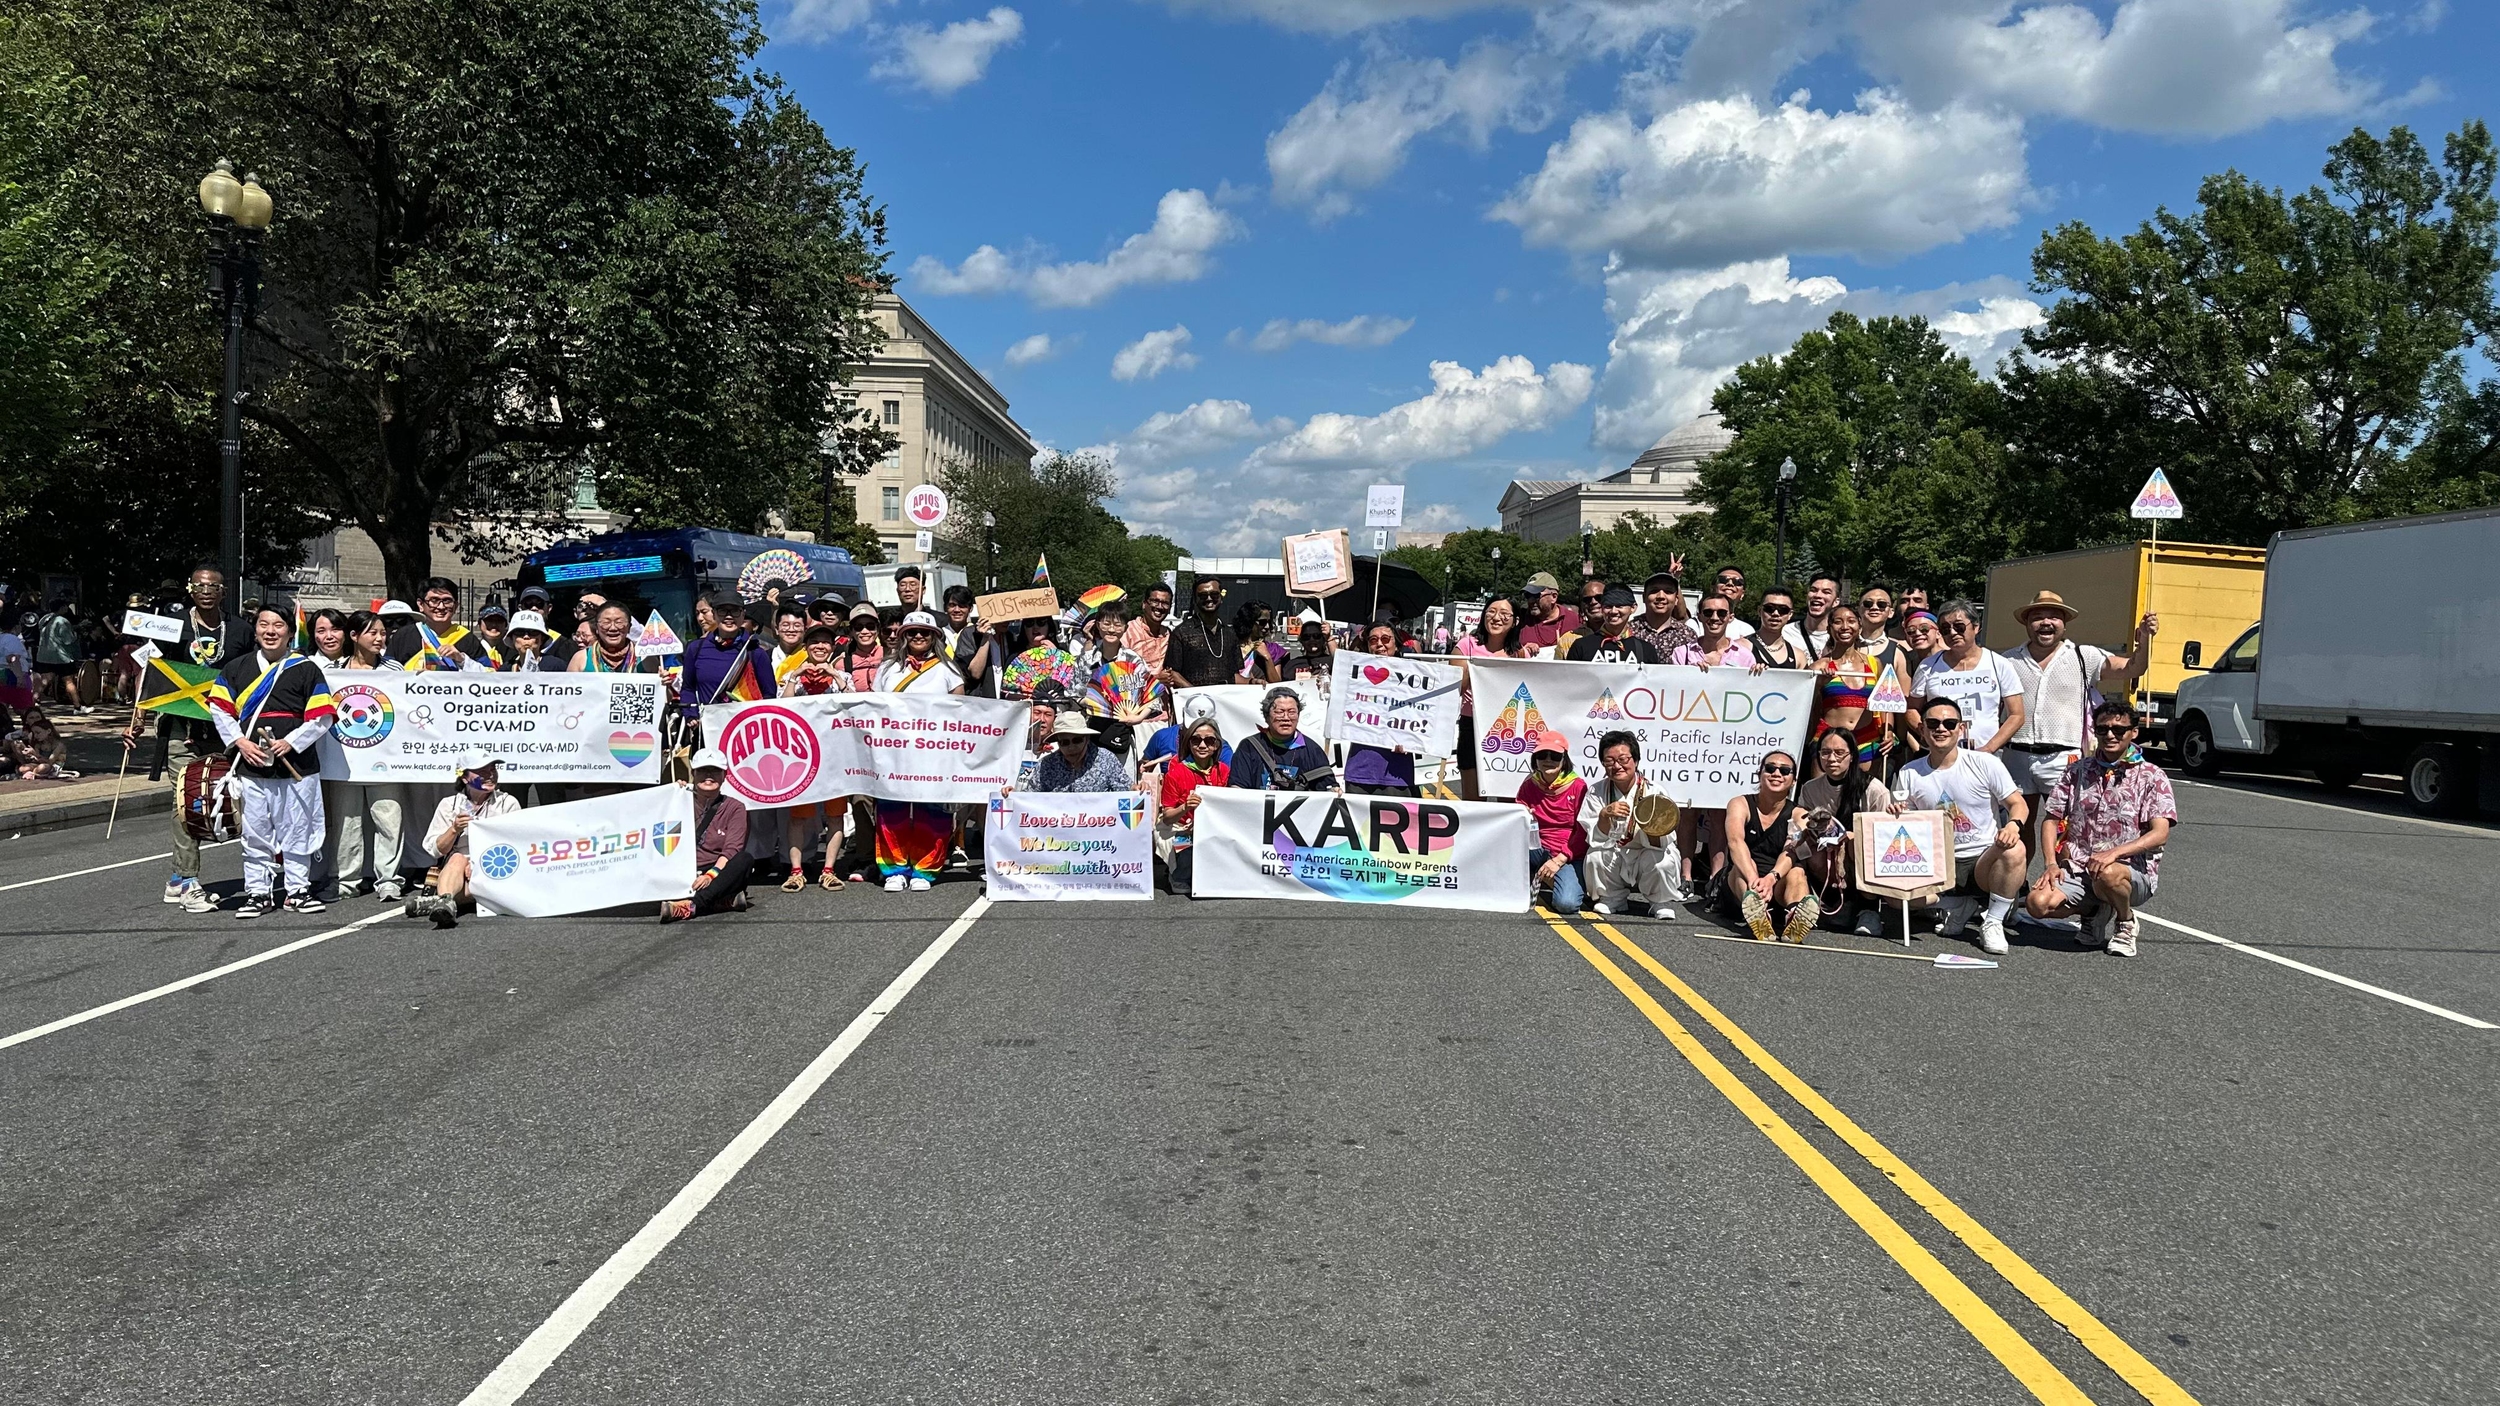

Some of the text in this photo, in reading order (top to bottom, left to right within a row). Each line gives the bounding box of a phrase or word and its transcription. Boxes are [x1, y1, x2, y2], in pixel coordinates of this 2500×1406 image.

[914, 493, 939, 508] APIQS
[1300, 561, 1331, 571] KhushDC
[982, 596, 1055, 617] JUST MARRIED
[1352, 665, 1359, 679] I
[1941, 676, 1989, 686] KQT DC
[340, 686, 380, 698] KQT DC
[405, 683, 583, 697] Korean Queer & Trans
[444, 701, 549, 717] Organization
[831, 717, 1009, 737] Asian Pacific Islander
[1387, 717, 1428, 733] are!
[731, 718, 809, 767] APIQS
[864, 734, 976, 753] Queer Society
[1637, 729, 1648, 742] &
[1661, 730, 1711, 744] Pacific
[1720, 731, 1784, 747] Islander
[402, 742, 425, 754] 한인
[429, 743, 470, 754] 성소수자
[1646, 749, 1762, 766] United for Acti
[391, 763, 452, 771] www.kqtdc.org
[519, 763, 611, 771] koreanqt.dc@gmail.com
[1582, 765, 1744, 786] WINGTON,
[726, 765, 817, 803] ASIAN PACIFIC ISLANDER QUEER SOCIETY
[845, 768, 880, 780] Visibility
[888, 772, 943, 782] Awareness
[951, 775, 1008, 785] Community
[1019, 813, 1116, 827] Love is Love
[1262, 794, 1460, 856] KARP
[527, 828, 646, 865] 성요한교회
[1020, 836, 1117, 855] We love you,
[547, 864, 572, 873] JOHN'S
[573, 859, 607, 869] EPISCOPAL
[609, 854, 638, 863] CHURCH
[997, 859, 1143, 878] We stand with you
[1262, 851, 1458, 873] Korean American Rainbow Parents
[1881, 865, 1928, 873] AQUADC
[1261, 864, 1458, 889] 미주 한인 무지개 부모모임
